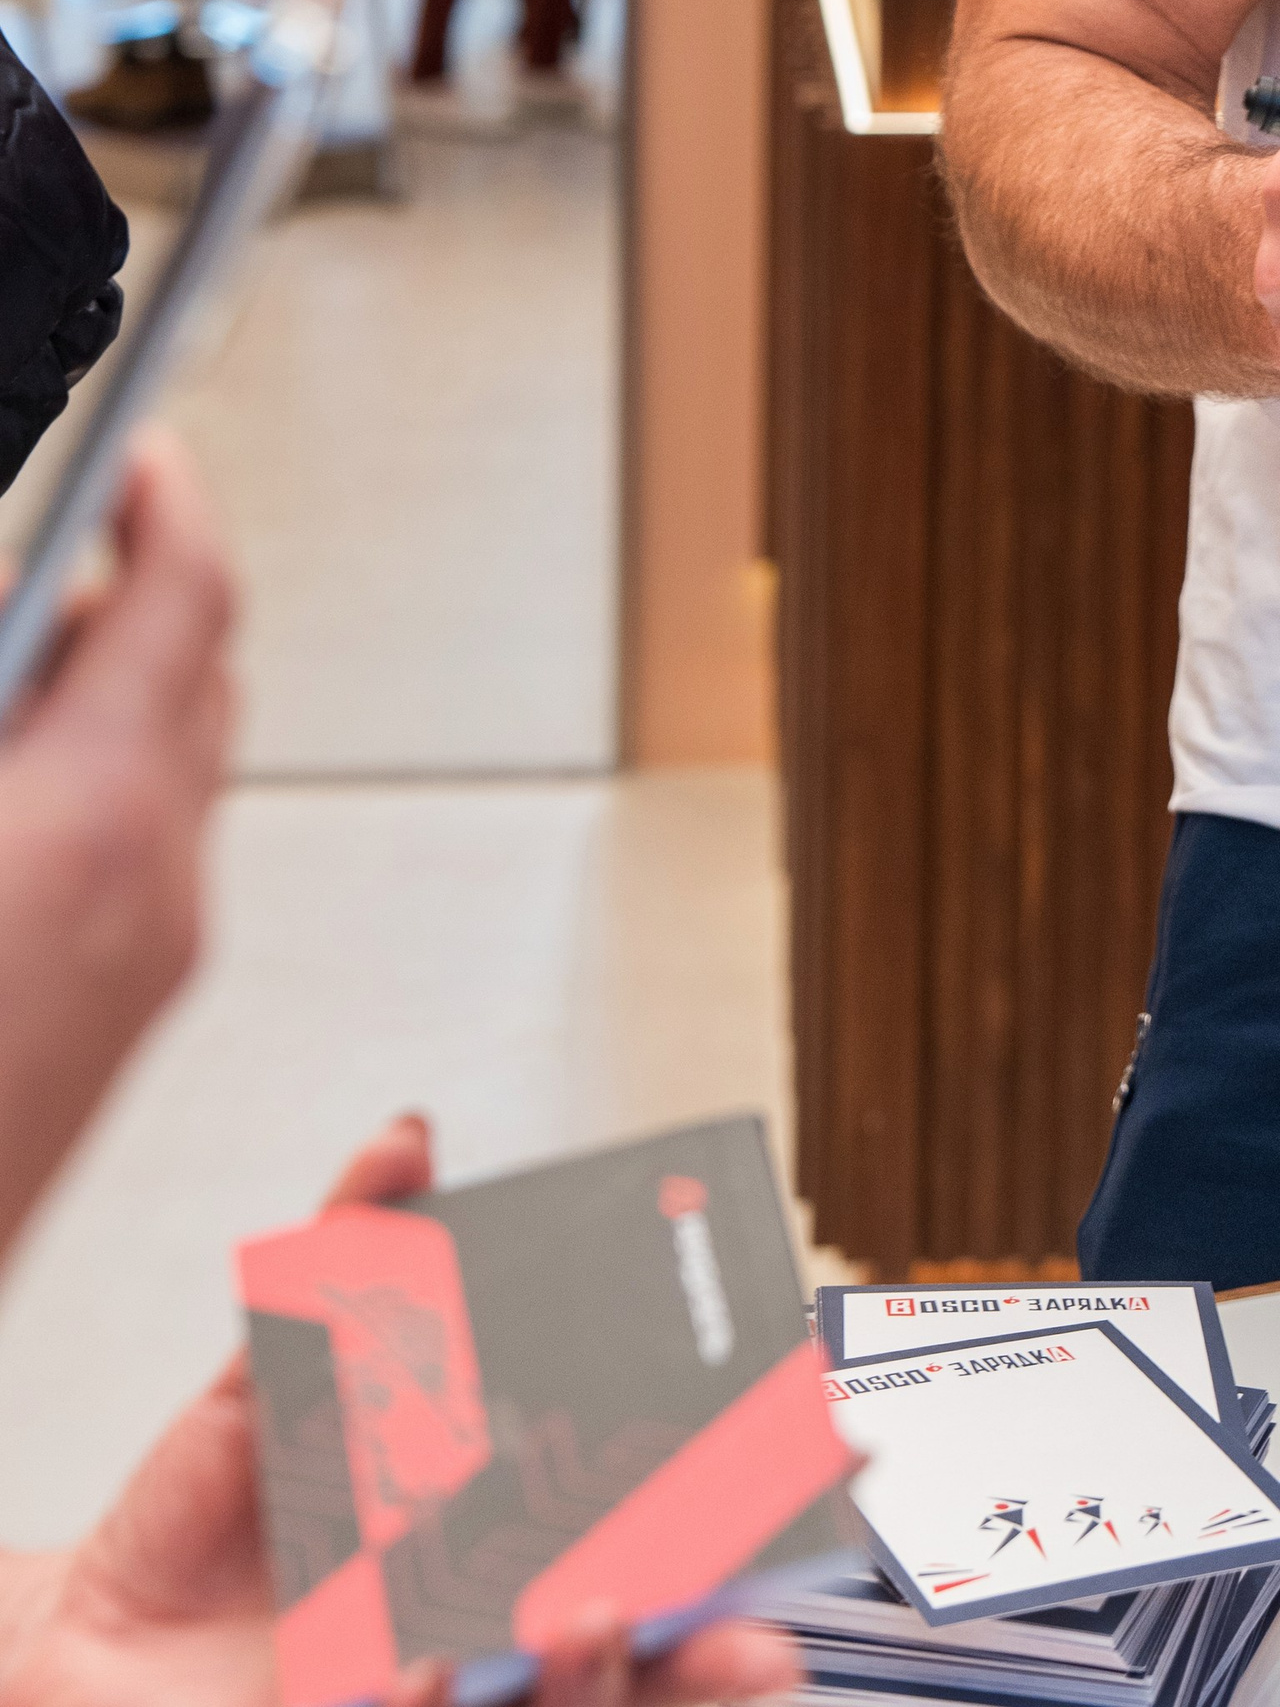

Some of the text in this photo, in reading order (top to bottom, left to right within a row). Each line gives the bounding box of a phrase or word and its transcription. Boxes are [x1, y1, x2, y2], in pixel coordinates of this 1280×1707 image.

[886, 1298, 1001, 1316] BOSCO
[1028, 1297, 1150, 1312] ЗАРЯДКА
[948, 1346, 1076, 1377] ЗАРЯДКА
[822, 1369, 932, 1401] BOSCO
